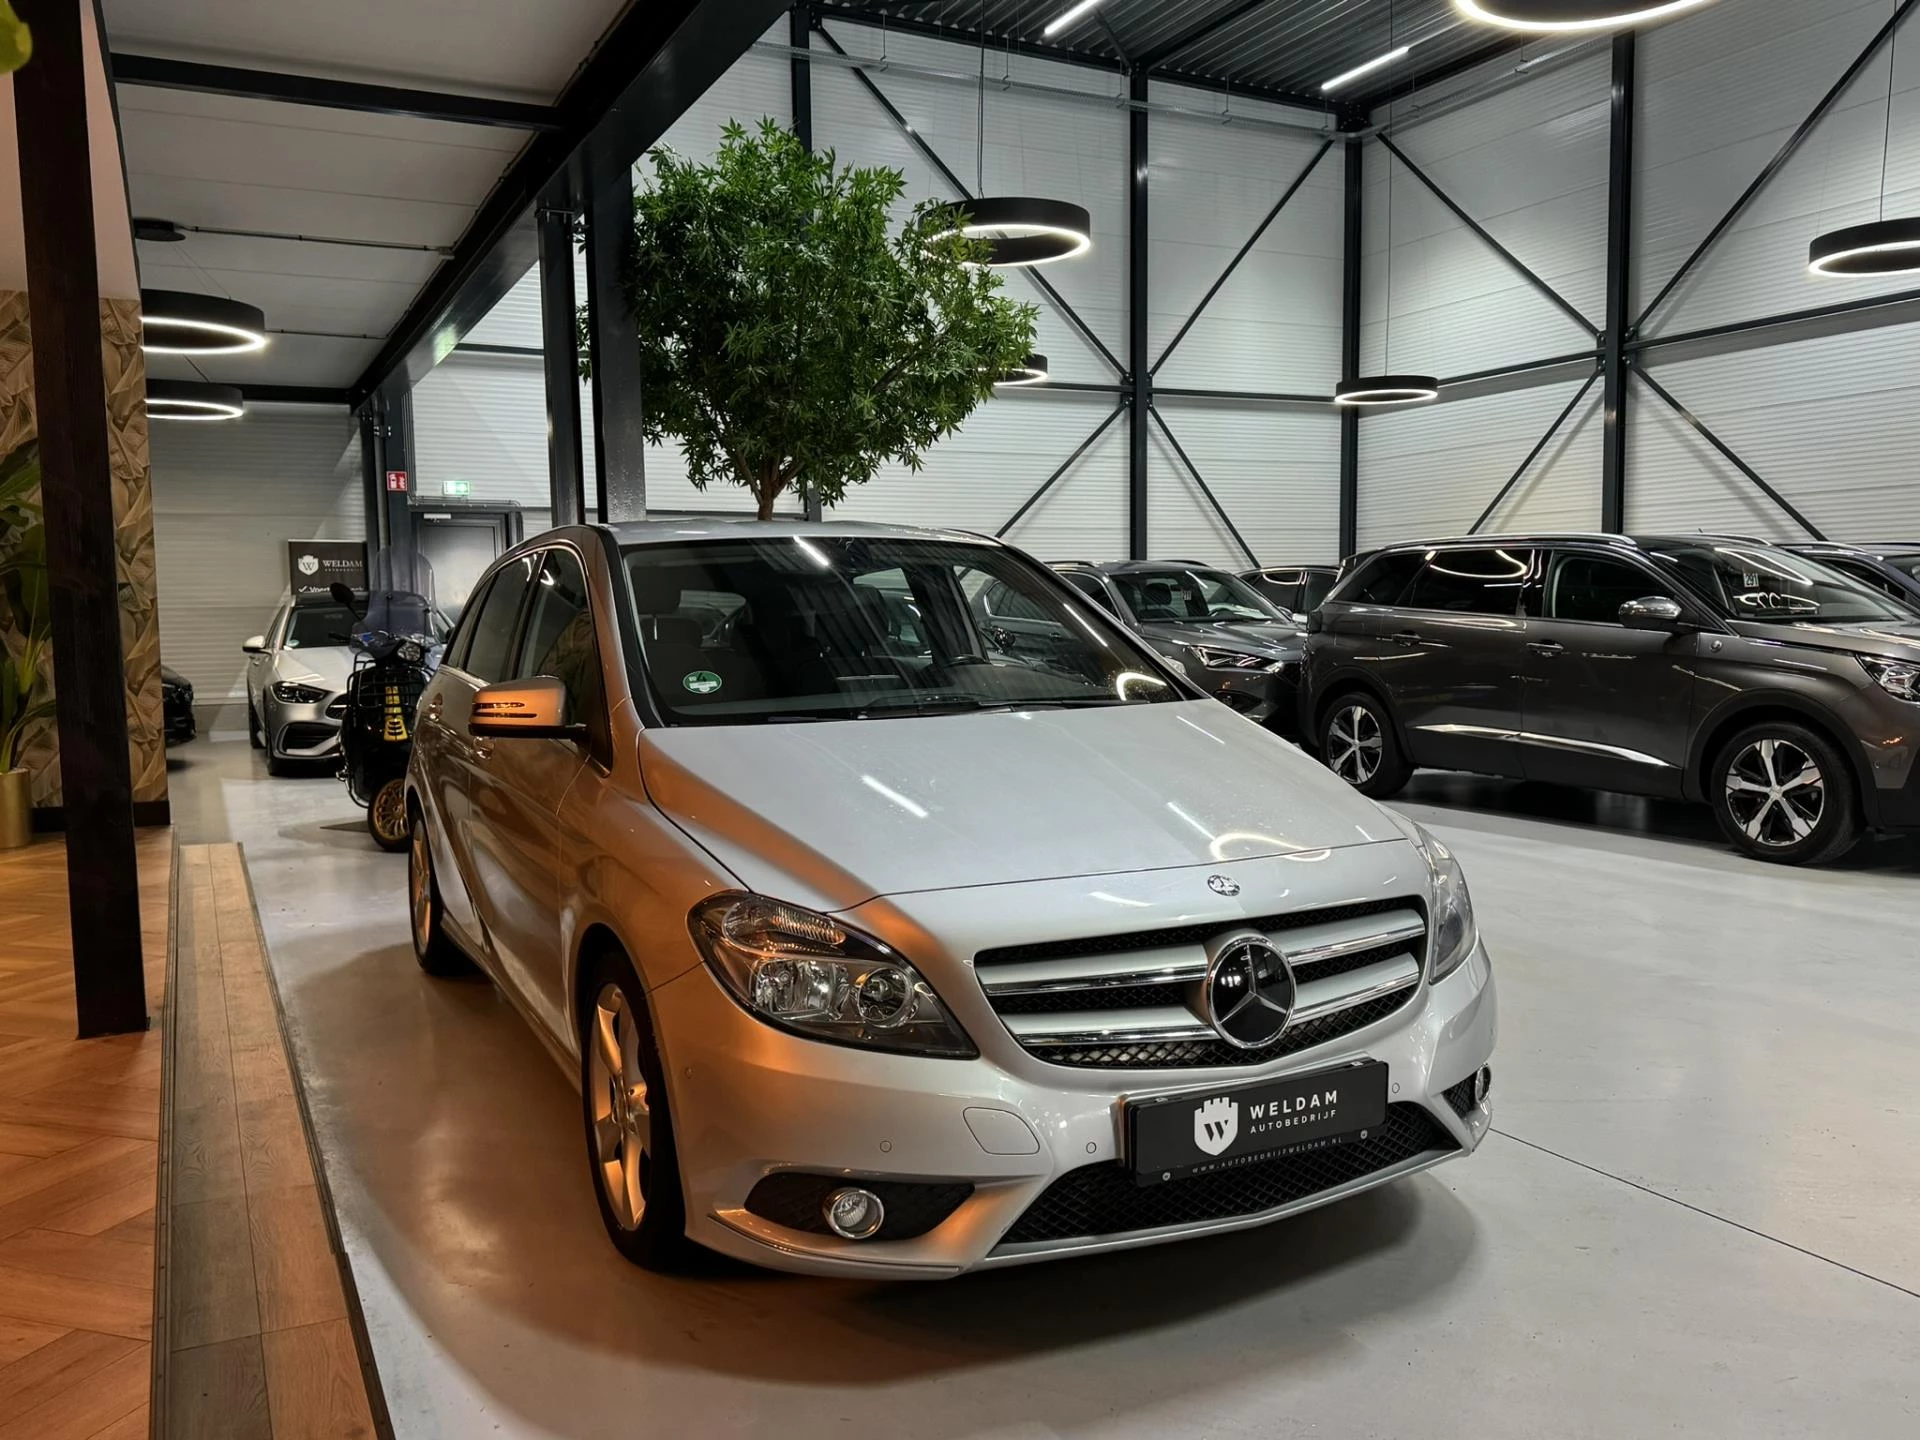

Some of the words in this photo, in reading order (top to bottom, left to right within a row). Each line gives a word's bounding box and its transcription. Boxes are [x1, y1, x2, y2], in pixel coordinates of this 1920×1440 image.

[322, 559, 363, 568] WELDAM
[1250, 1090, 1337, 1120] WELDAM
[1250, 1109, 1336, 1134] AUTOBEDRIJF
